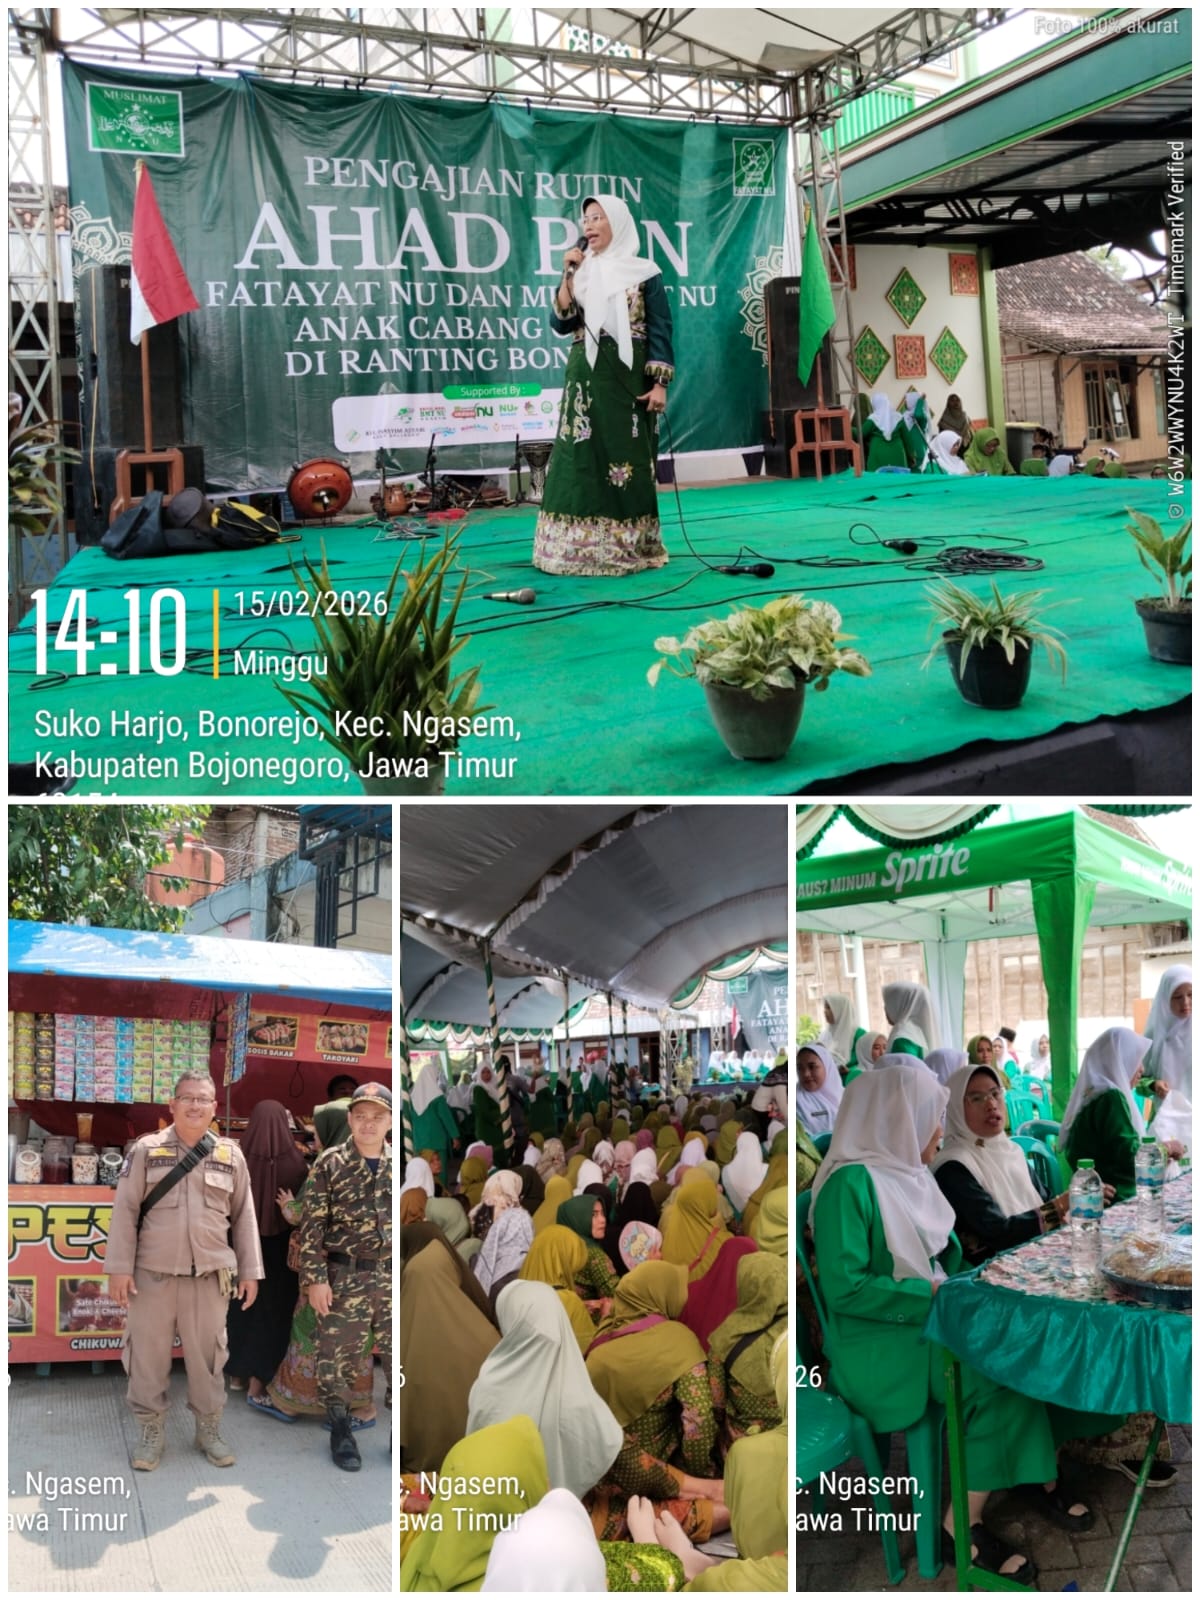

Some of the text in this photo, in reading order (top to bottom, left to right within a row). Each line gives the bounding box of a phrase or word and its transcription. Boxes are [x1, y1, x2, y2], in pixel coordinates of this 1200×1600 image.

[103, 90, 167, 105] MUSLIMAT
[304, 156, 643, 203] PENGAJIAN RUTIN
[233, 202, 693, 277] AHAD PN
[206, 281, 381, 307] FATAYAT
[389, 281, 438, 306] NU
[446, 283, 513, 308] DAN
[680, 286, 717, 307] NU
[294, 316, 402, 342] ANAK
[409, 316, 543, 340] CABANG
[284, 351, 328, 377] DI
[338, 347, 498, 376] RANTING
[460, 386, 507, 398] Supported
[880, 844, 971, 893] Sprite
[797, 872, 876, 898] AUS? MINUM
